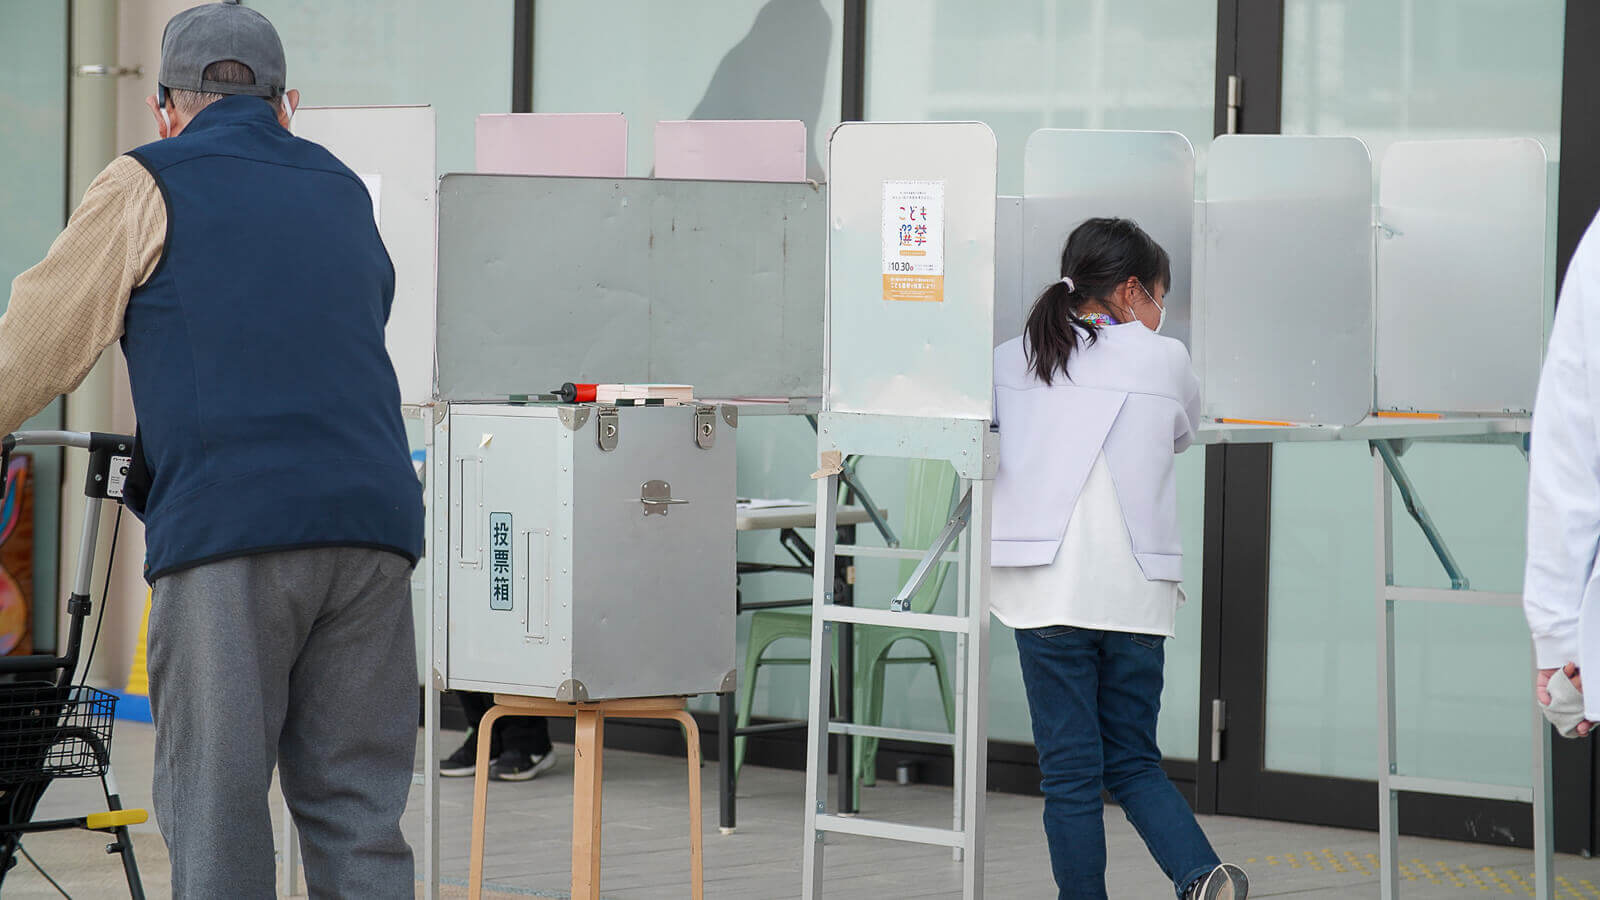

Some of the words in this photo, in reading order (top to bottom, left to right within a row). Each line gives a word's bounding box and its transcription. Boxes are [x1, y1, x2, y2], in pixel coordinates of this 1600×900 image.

[899, 206, 927, 221] こども
[899, 224, 927, 246] 選挙
[493, 522, 509, 601] 投票箱
